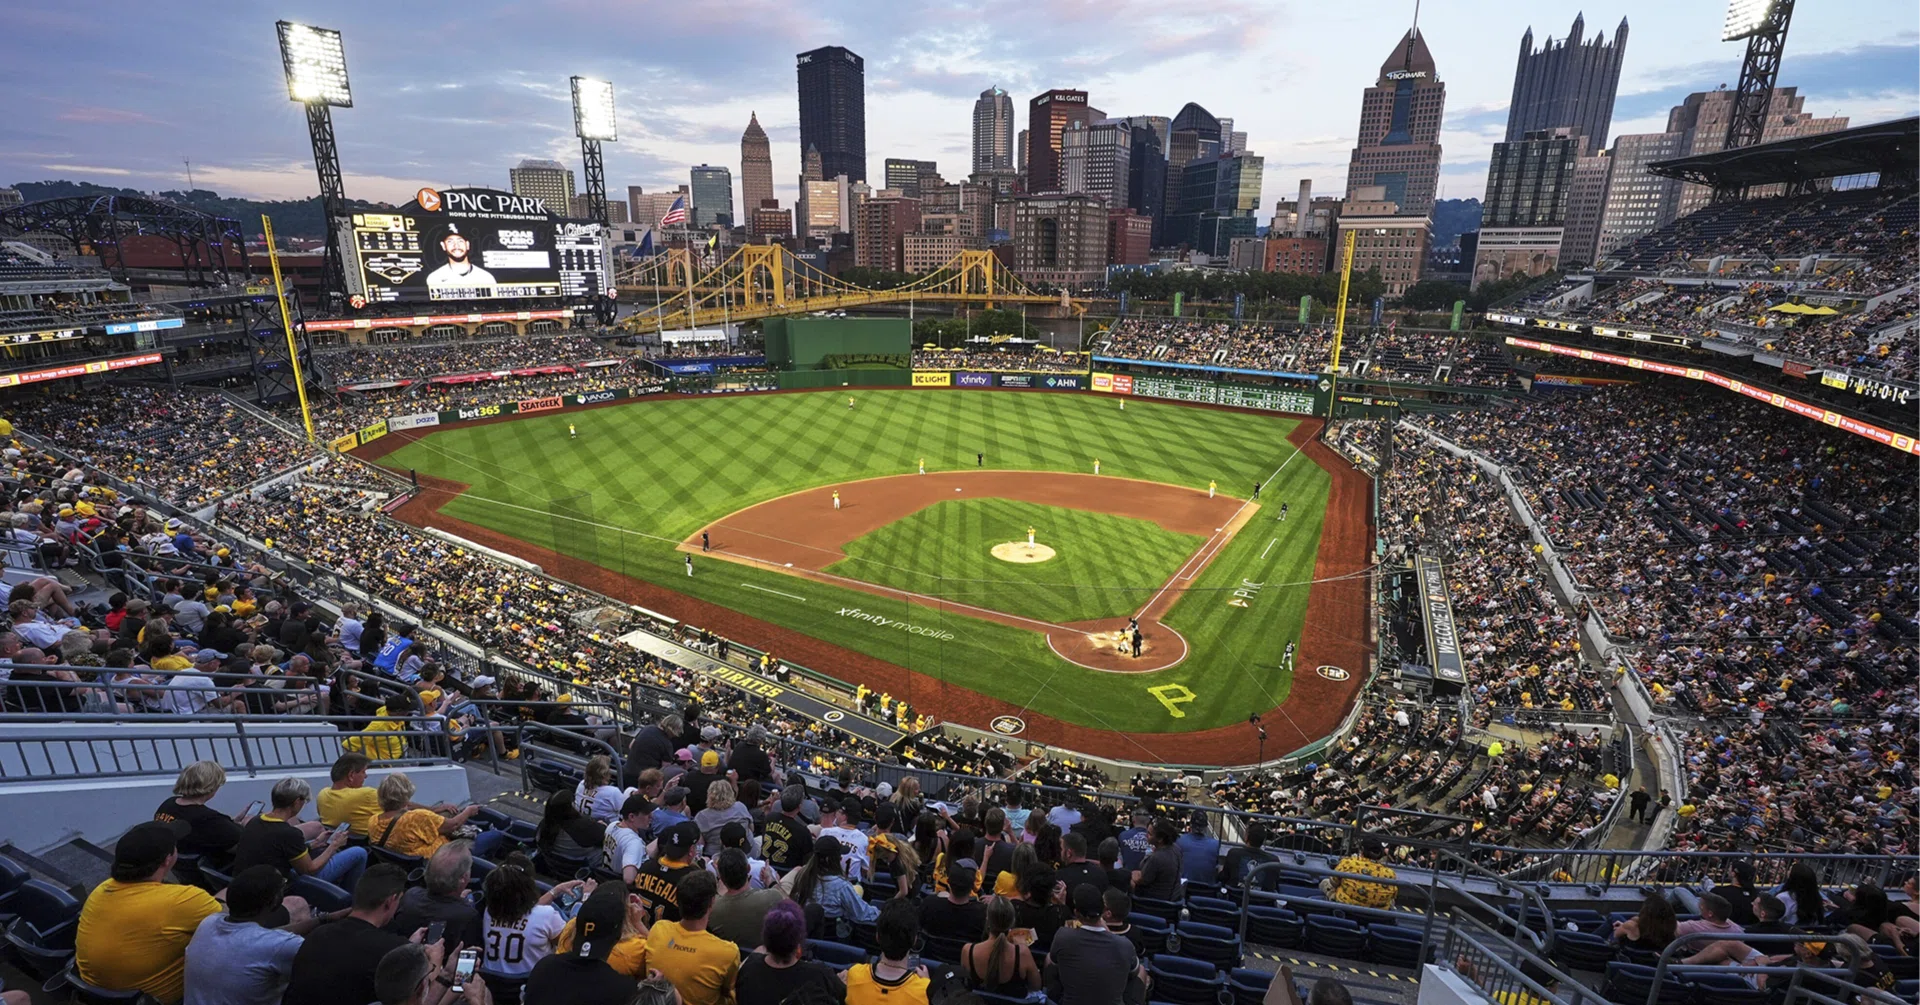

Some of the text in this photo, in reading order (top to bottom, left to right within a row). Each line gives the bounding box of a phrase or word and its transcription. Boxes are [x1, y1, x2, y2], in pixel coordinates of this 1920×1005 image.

[800, 55, 812, 64] PNC
[1390, 71, 1426, 79] HIGHMARK
[443, 192, 547, 214] PNC PARK
[405, 217, 415, 230] P
[565, 223, 600, 237] Chicago
[498, 230, 533, 238] EDGAR
[961, 375, 987, 384] xfinity
[1057, 379, 1076, 387] AHN
[585, 391, 615, 401] VANDA
[637, 386, 663, 395] BETMGM
[458, 405, 500, 419] bet365
[521, 398, 560, 412] SEATGEEK
[415, 416, 436, 425] paze
[1233, 578, 1265, 599] PNC
[1428, 581, 1443, 596] PNC
[1430, 602, 1446, 611] TO
[835, 607, 954, 641] xfinity mobile
[1434, 611, 1456, 654] WELCOME
[711, 667, 784, 698] PIRATES
[1147, 683, 1197, 718] P
[579, 799, 594, 816] 15
[761, 835, 789, 864] 22
[584, 922, 595, 936] P
[487, 930, 525, 963] 30
[673, 943, 697, 953] PEOPLES
